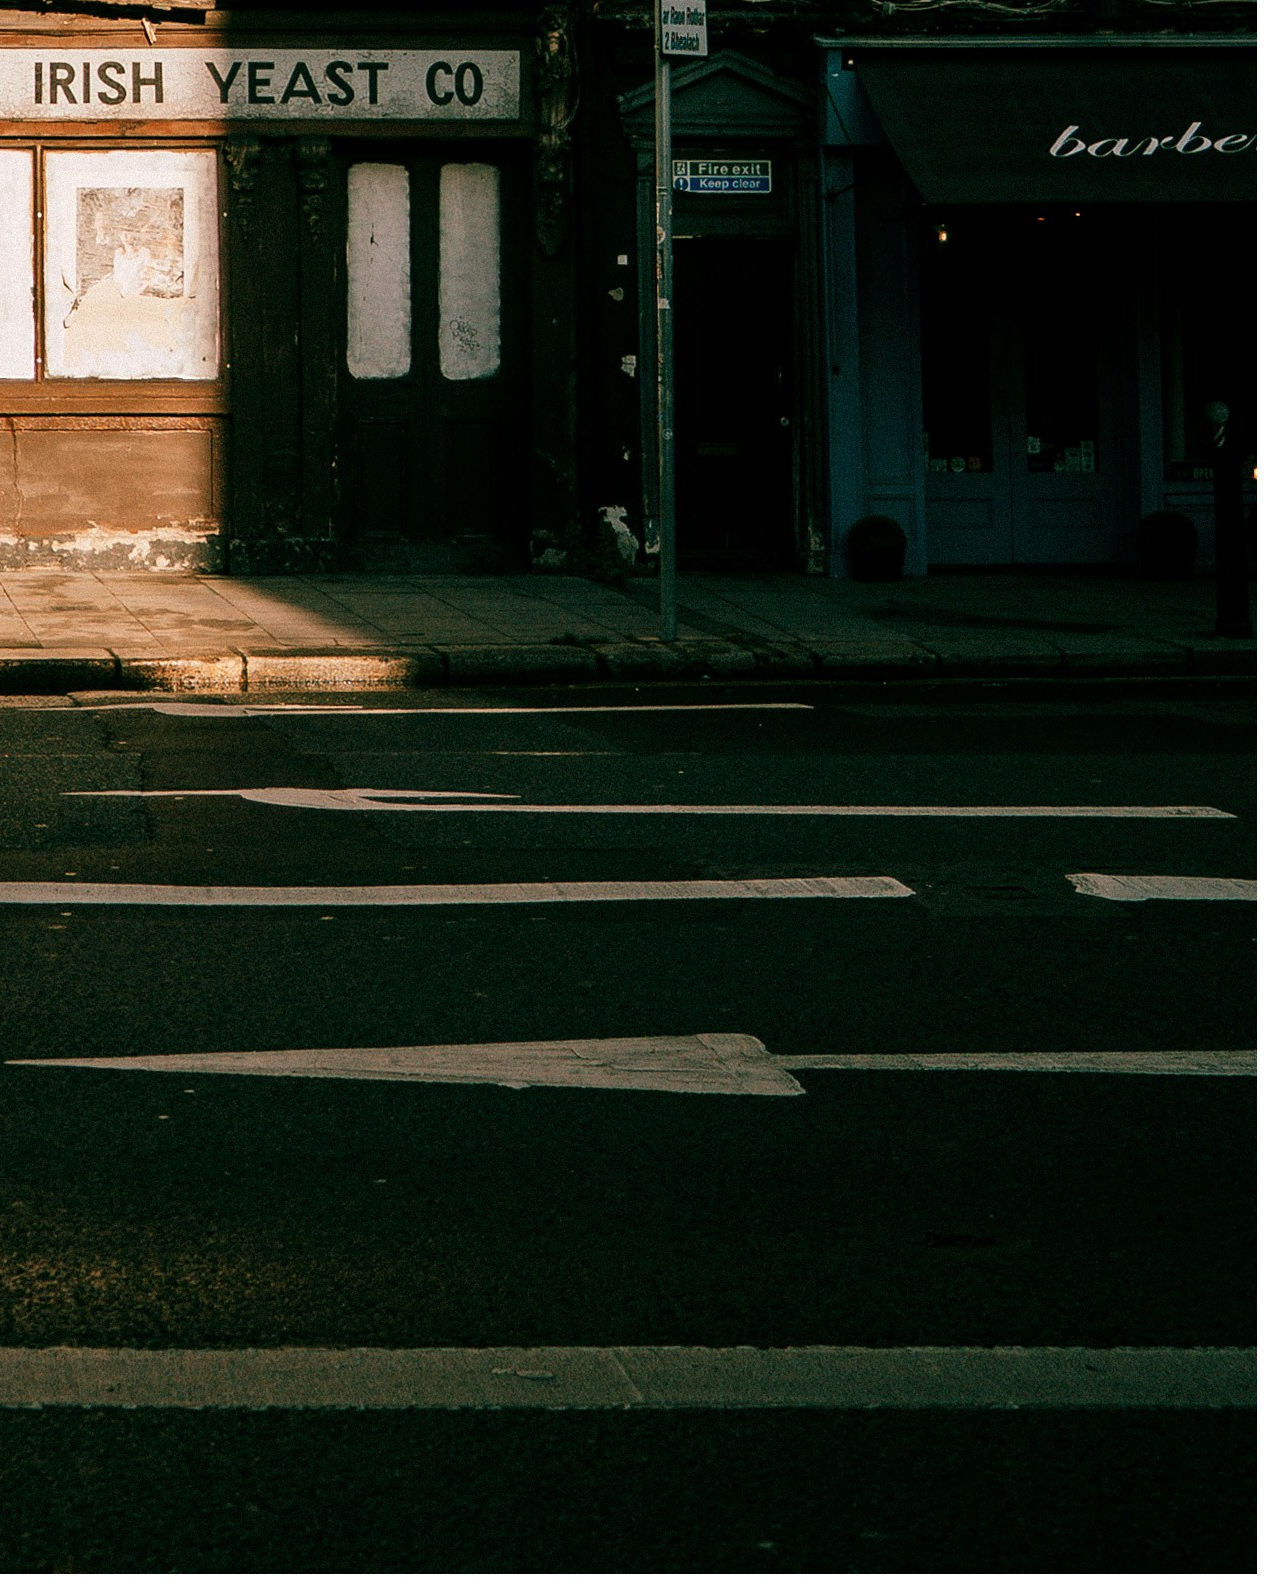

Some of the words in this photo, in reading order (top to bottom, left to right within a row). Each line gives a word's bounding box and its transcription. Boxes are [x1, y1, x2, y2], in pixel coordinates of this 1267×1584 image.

[664, 31, 670, 50] 2
[34, 62, 164, 105] IRISH
[205, 61, 389, 106] YEAST
[425, 60, 484, 108] CO
[1048, 121, 1257, 158] barbe
[698, 163, 729, 175] Fire
[732, 163, 761, 175] exit
[699, 178, 729, 190] Keep
[731, 178, 761, 189] clear
